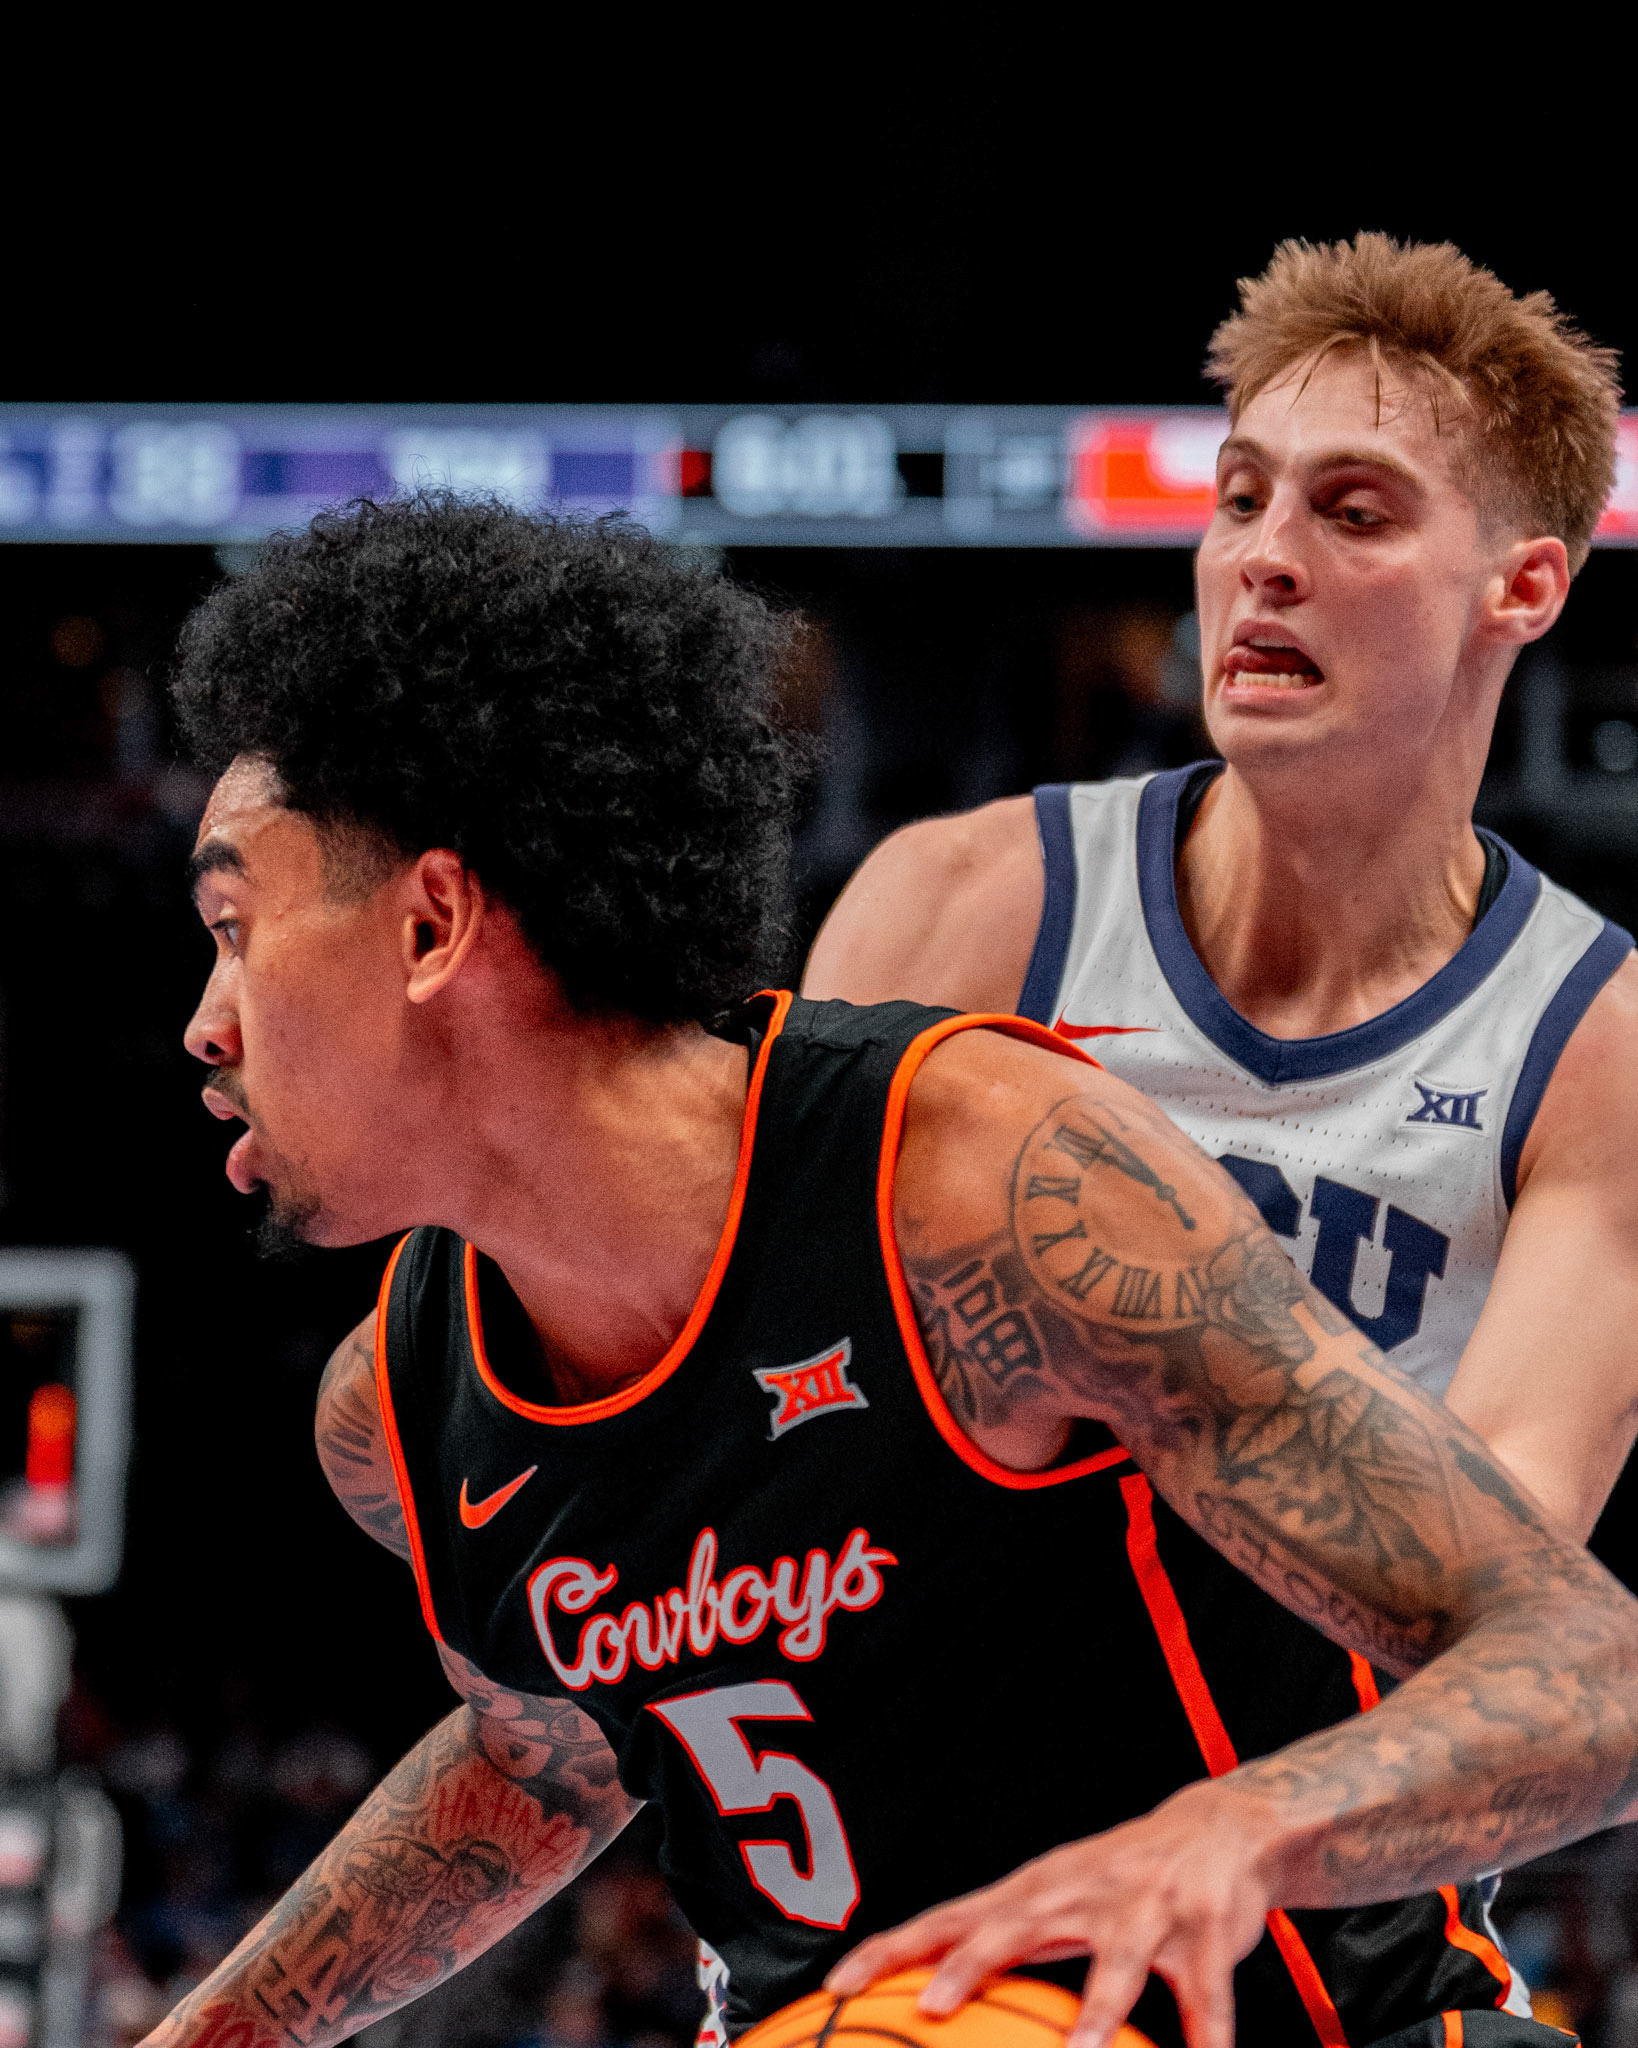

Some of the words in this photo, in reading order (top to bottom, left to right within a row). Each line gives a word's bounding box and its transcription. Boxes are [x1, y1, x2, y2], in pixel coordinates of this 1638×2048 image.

[1406, 1081, 1489, 1131] XII
[761, 1347, 860, 1429] XII
[527, 1527, 899, 1691] Cowboys
[645, 1679, 861, 1930] 5
